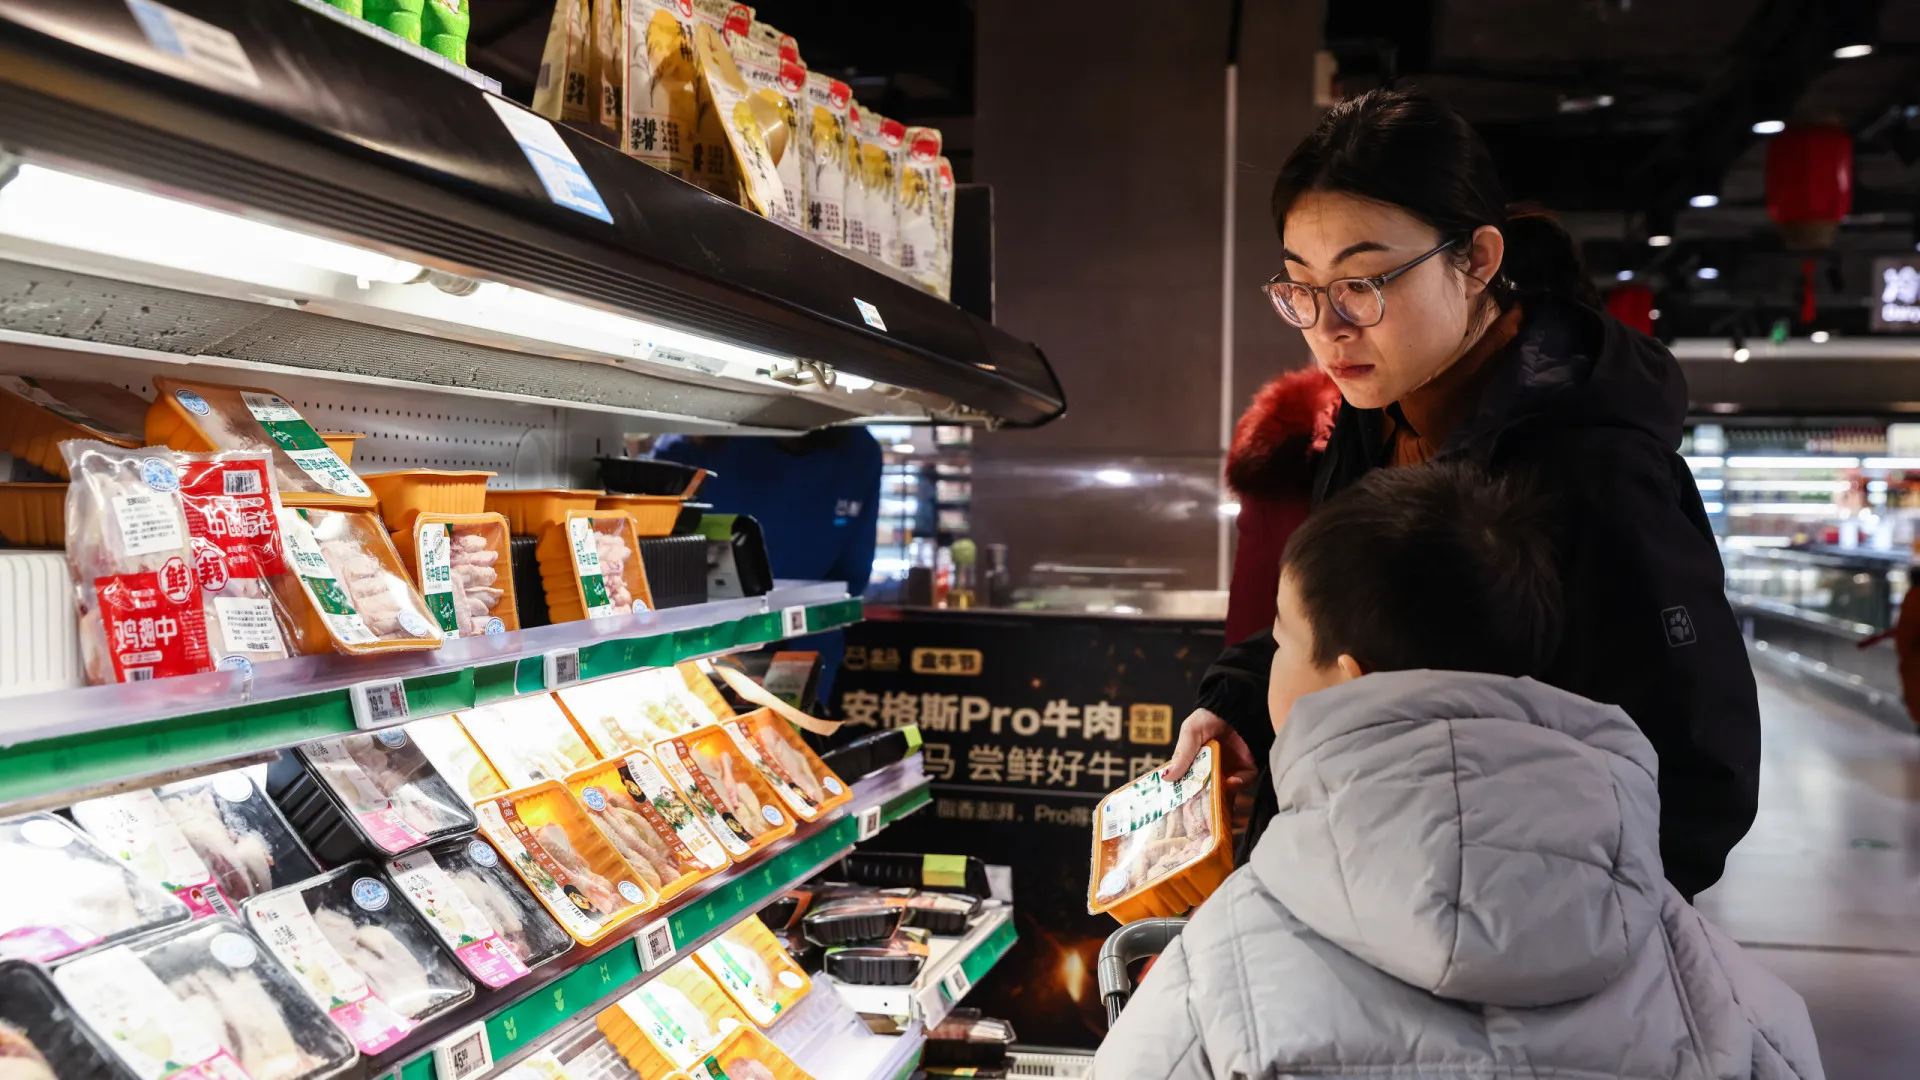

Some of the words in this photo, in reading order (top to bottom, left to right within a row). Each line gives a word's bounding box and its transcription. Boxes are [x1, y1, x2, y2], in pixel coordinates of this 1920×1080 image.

[166, 563, 188, 595] 鲜
[111, 616, 178, 653] 鸡翅中
[841, 690, 1122, 741] 安格斯Pro牛肉
